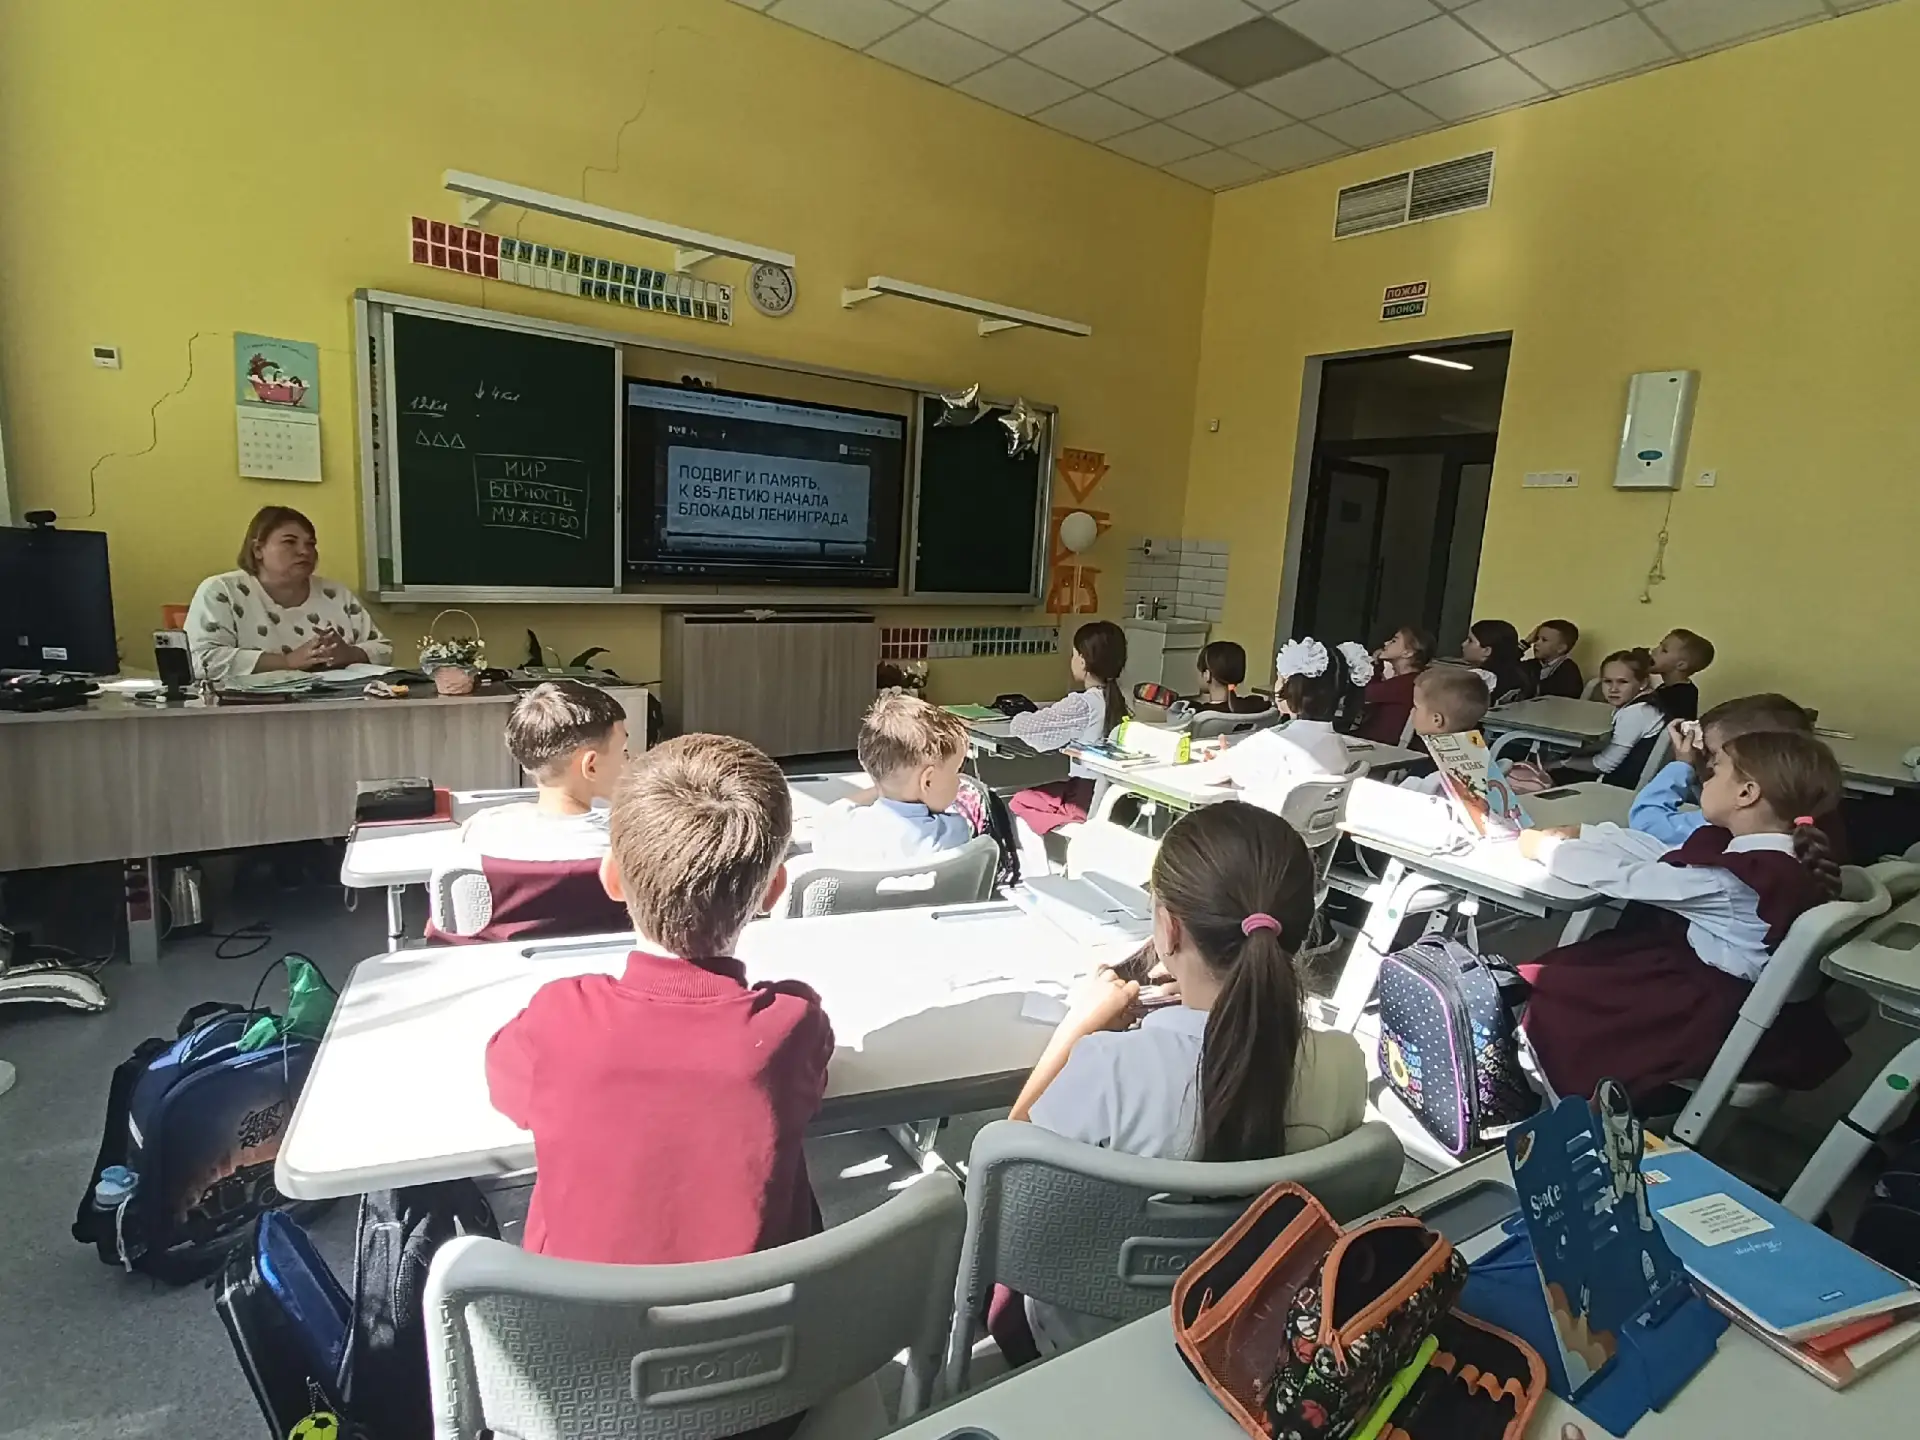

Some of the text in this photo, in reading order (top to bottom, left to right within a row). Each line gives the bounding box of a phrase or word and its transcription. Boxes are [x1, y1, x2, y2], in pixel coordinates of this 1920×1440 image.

[720, 288, 729, 301] Ъ
[1387, 284, 1425, 299] ПОЖАР
[721, 308, 729, 321] Ь
[1385, 302, 1423, 316] ЗВОНОК
[505, 460, 547, 479] МИР
[678, 464, 742, 484] ПОДВИГ
[745, 470, 756, 484] И
[489, 480, 573, 507] ВЕРНОСТЬ
[679, 483, 829, 508] К 85-ЛЕТИЮ НАЧАЛА
[492, 506, 580, 529] МУЖЕСТВО
[678, 503, 849, 527] БЛОКАДЫ ЛЕНИНГРАДА
